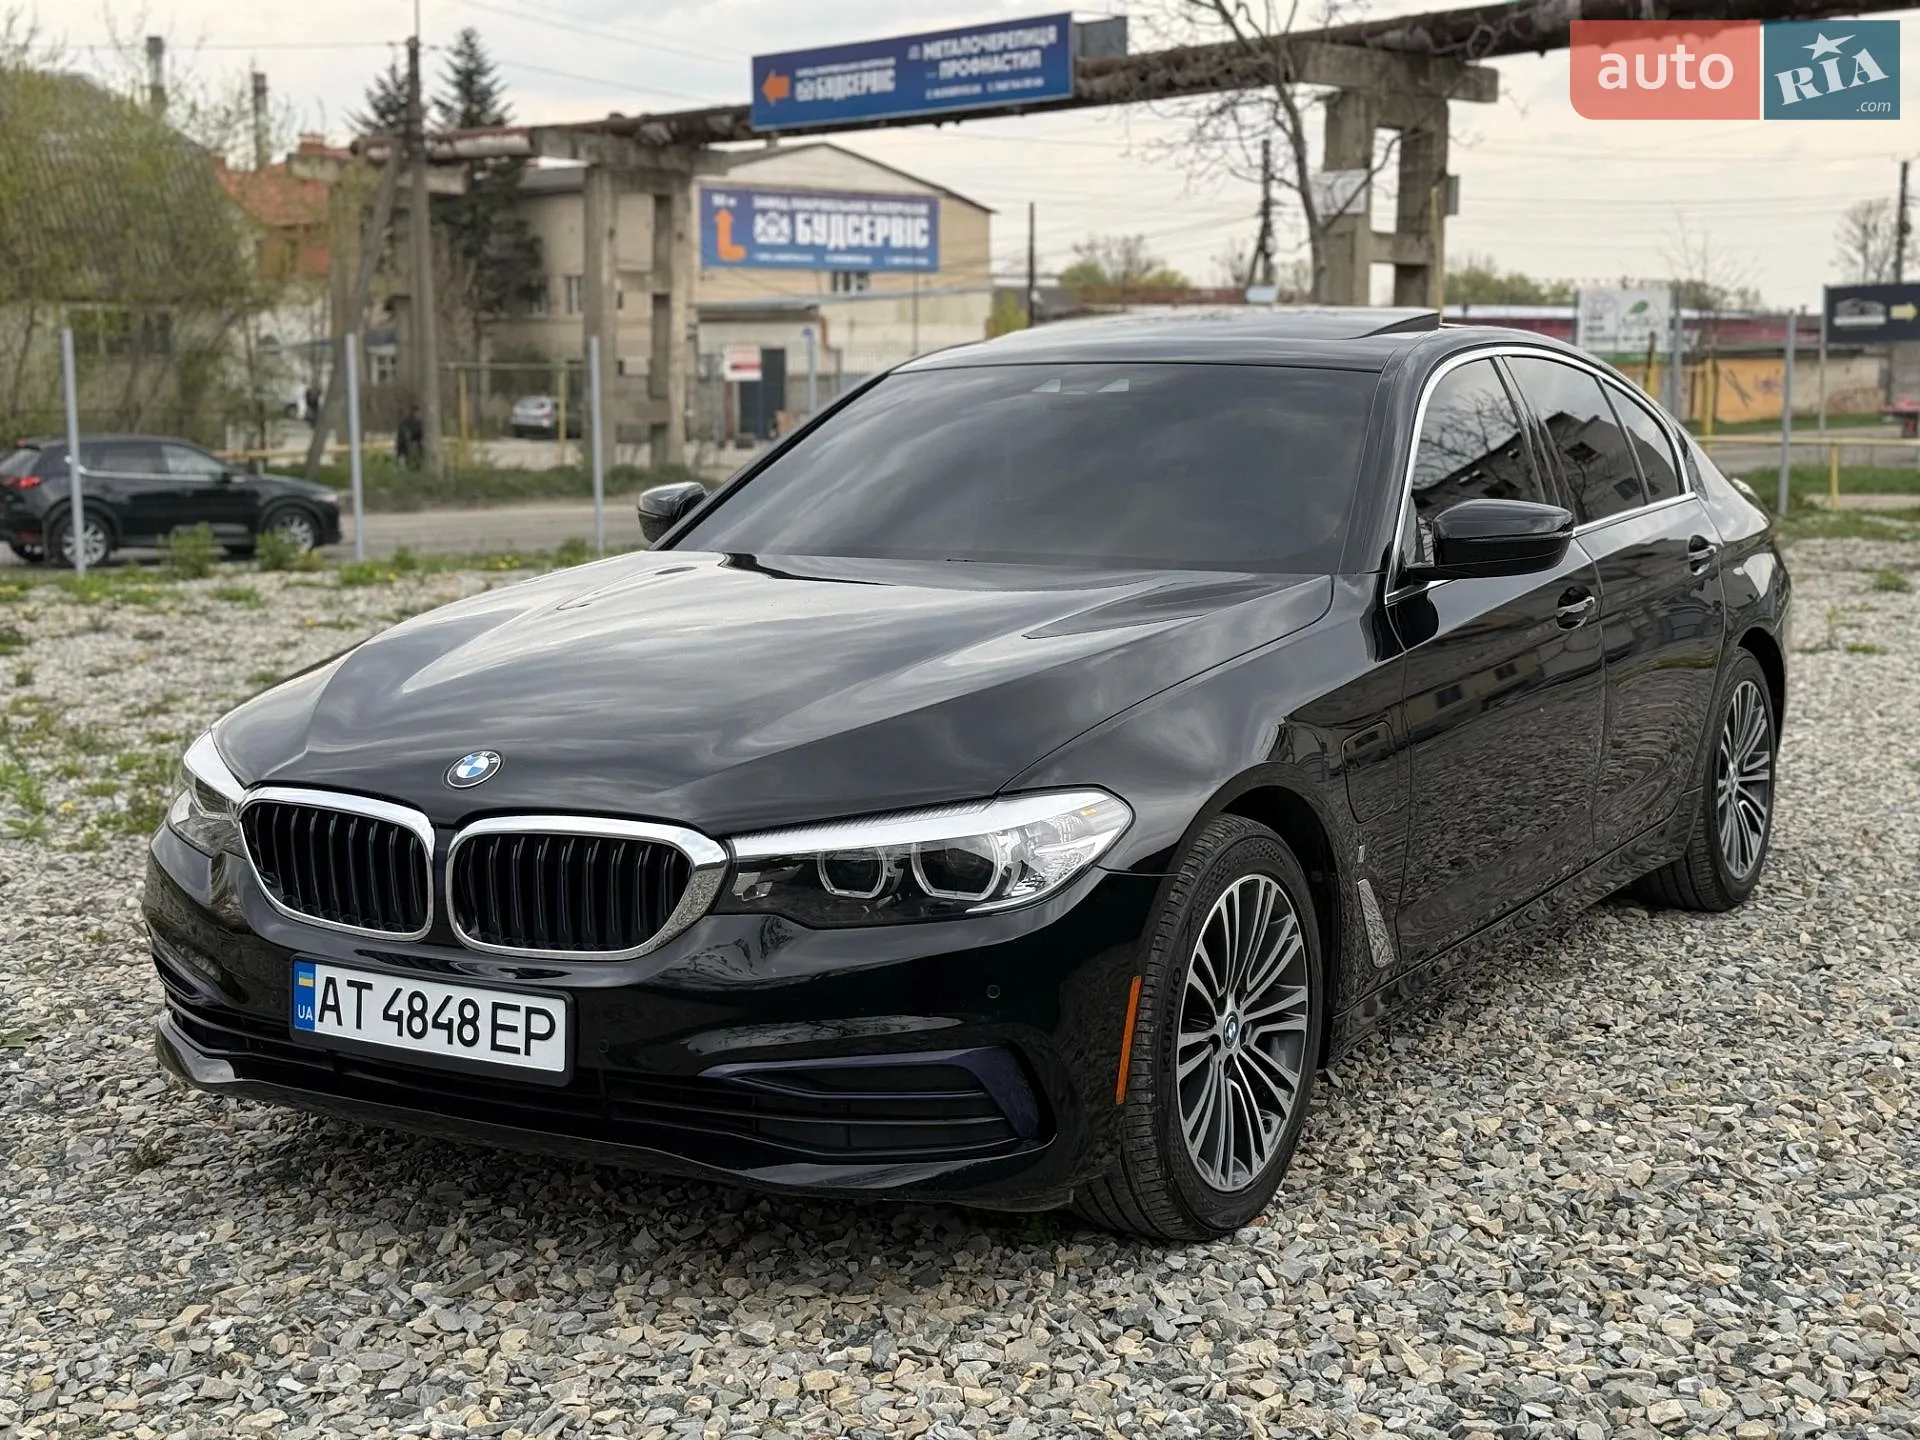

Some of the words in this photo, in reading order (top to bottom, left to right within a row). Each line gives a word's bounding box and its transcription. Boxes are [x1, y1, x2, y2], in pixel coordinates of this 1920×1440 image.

[922, 25, 1057, 61] МЕТАЛОЧЕРЕПИЦЯ
[939, 50, 1041, 80] ПРОФНАСТИЛ
[816, 68, 896, 101] БУДСЕРВІС
[795, 212, 929, 251] БУДСЕРВІС
[297, 1005, 314, 1021] UA
[317, 976, 374, 1030] AT
[382, 988, 480, 1048] 4848
[490, 1001, 556, 1056] EP
